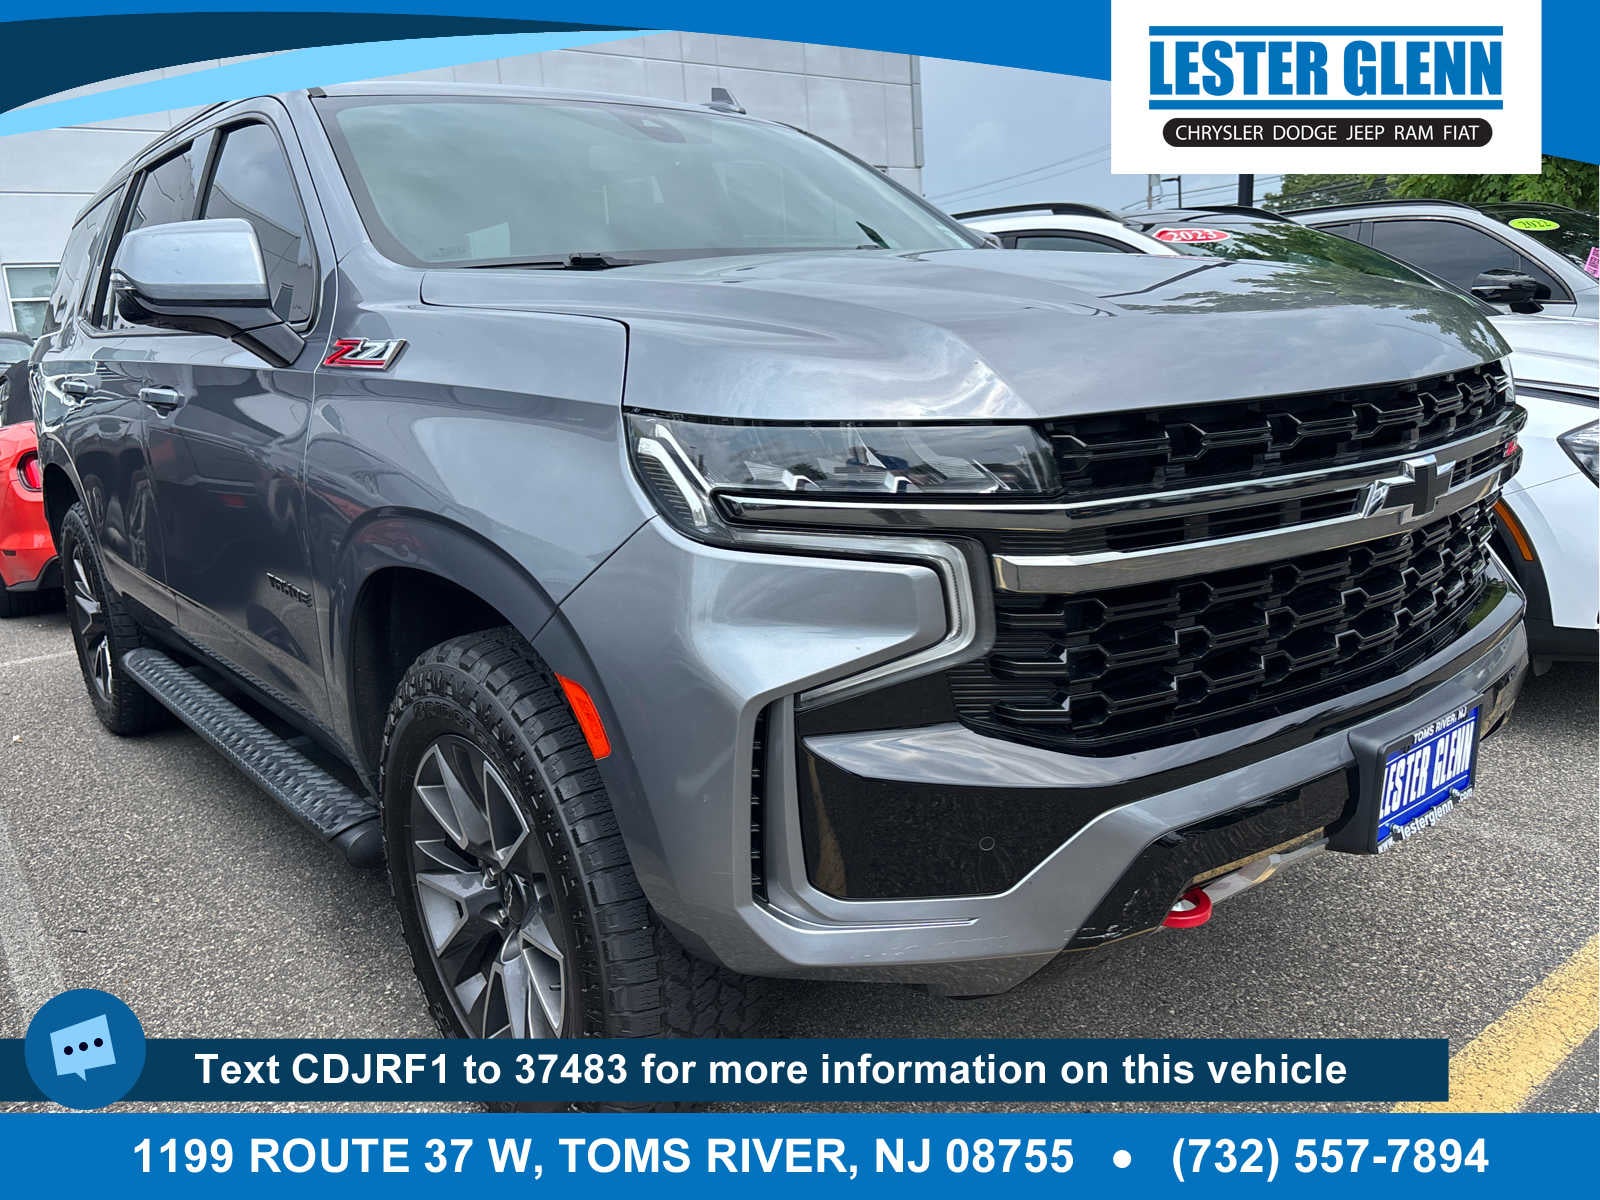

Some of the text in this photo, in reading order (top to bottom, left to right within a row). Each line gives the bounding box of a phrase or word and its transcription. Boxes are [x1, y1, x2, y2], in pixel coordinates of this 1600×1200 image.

[1166, 228, 1217, 241] 2023
[322, 337, 407, 371] Z71
[1413, 724, 1435, 744] TOMS
[1457, 706, 1468, 722] NJ
[1379, 720, 1475, 820] LESTER GLENN
